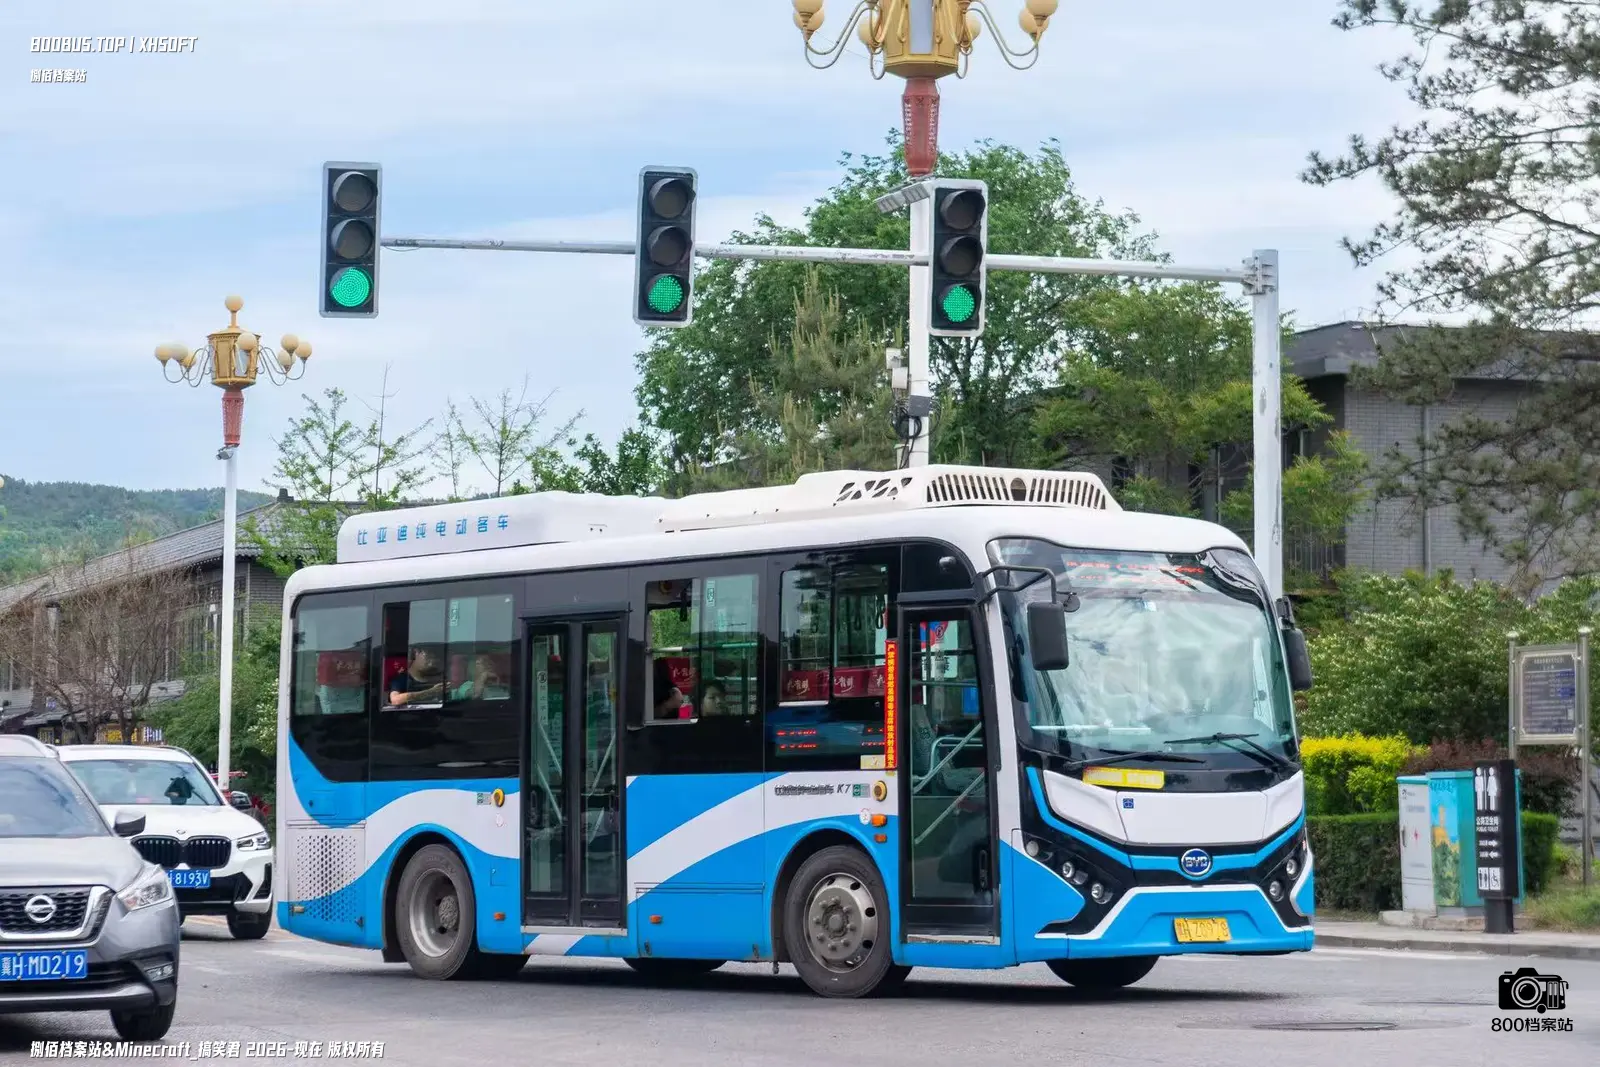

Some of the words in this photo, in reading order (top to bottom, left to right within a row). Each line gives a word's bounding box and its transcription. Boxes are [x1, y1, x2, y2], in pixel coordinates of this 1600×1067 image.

[357, 514, 509, 546] 比亚迪纯电动客车
[837, 784, 851, 794] K7
[1185, 856, 1208, 867] BYD
